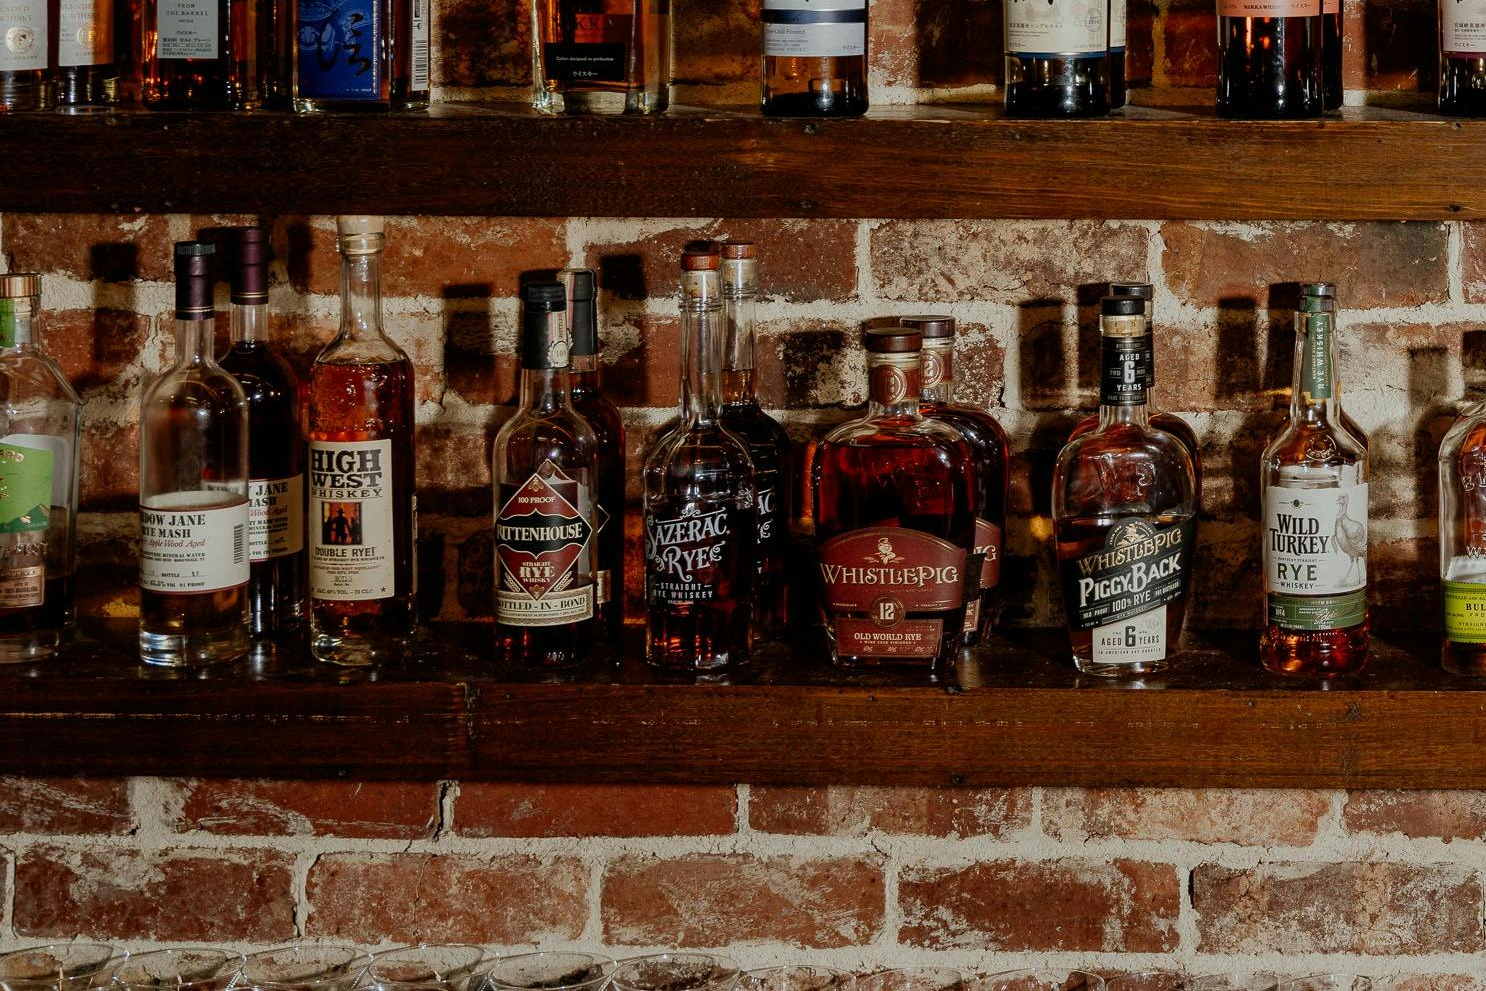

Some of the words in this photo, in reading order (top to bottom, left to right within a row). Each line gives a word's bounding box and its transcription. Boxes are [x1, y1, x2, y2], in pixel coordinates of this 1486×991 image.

[1120, 353, 1140, 361] AGED
[1125, 361, 1135, 383] 6
[1117, 383, 1141, 391] YEARS
[1317, 372, 1325, 390] RYE
[311, 449, 381, 473] HIGH
[311, 472, 382, 488] WEST
[256, 482, 288, 496] JANE
[169, 514, 206, 526] JANE
[1277, 513, 1319, 535] WILD
[159, 529, 191, 538] MASH
[164, 539, 183, 548] Wood
[186, 539, 206, 548] Aged
[1270, 528, 1330, 556] TURKEY
[315, 547, 347, 557] DOUBLE
[663, 546, 710, 582] RYE
[519, 566, 555, 578] RYE
[1277, 563, 1318, 581] RYE
[1279, 581, 1314, 589] WHISKEY
[671, 591, 713, 599] WHISKEY
[1134, 590, 1151, 606] RYE
[561, 598, 585, 608] BOND
[880, 603, 895, 620] 12
[872, 633, 903, 641] WORLD
[905, 633, 921, 641] RYE
[1101, 636, 1122, 646] AGED
[1125, 625, 1136, 647] 6
[1139, 635, 1160, 645] YEARS
